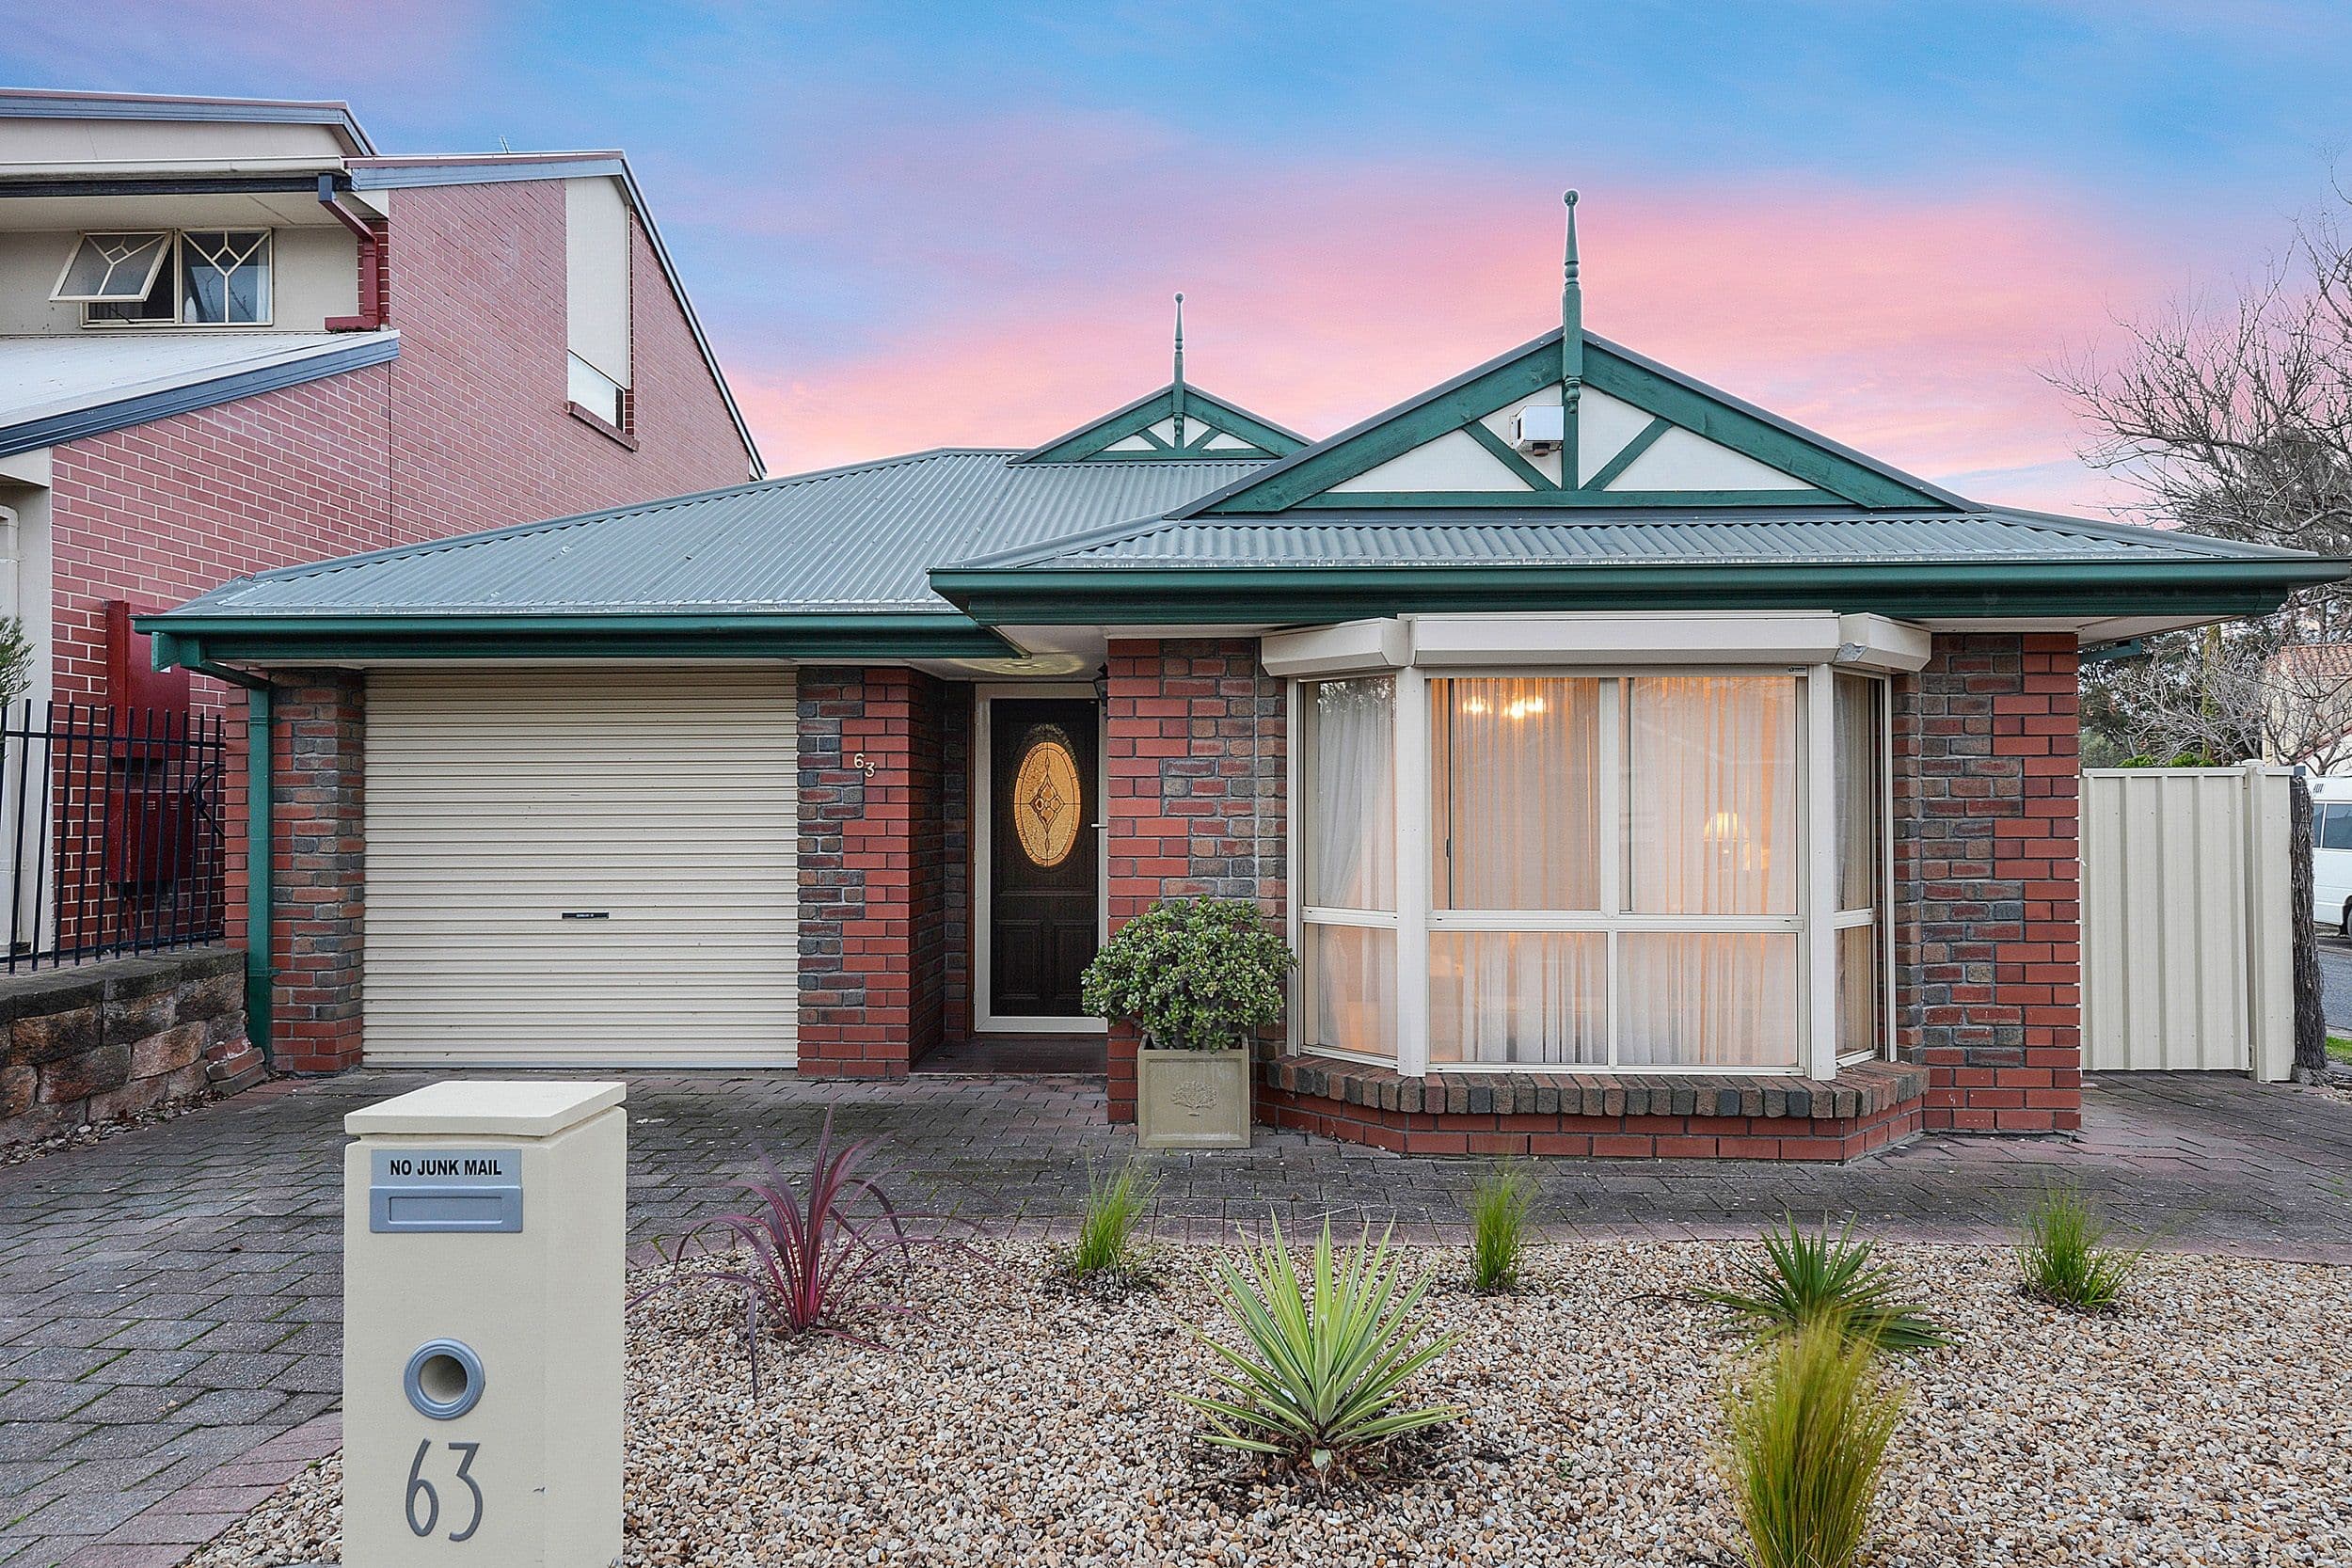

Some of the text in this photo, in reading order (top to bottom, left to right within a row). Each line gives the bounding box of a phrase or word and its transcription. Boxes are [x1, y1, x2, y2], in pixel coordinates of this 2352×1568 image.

[854, 752, 875, 778] 63
[390, 1160, 502, 1176] NO JUNK MAIL
[405, 1437, 483, 1543] 63
